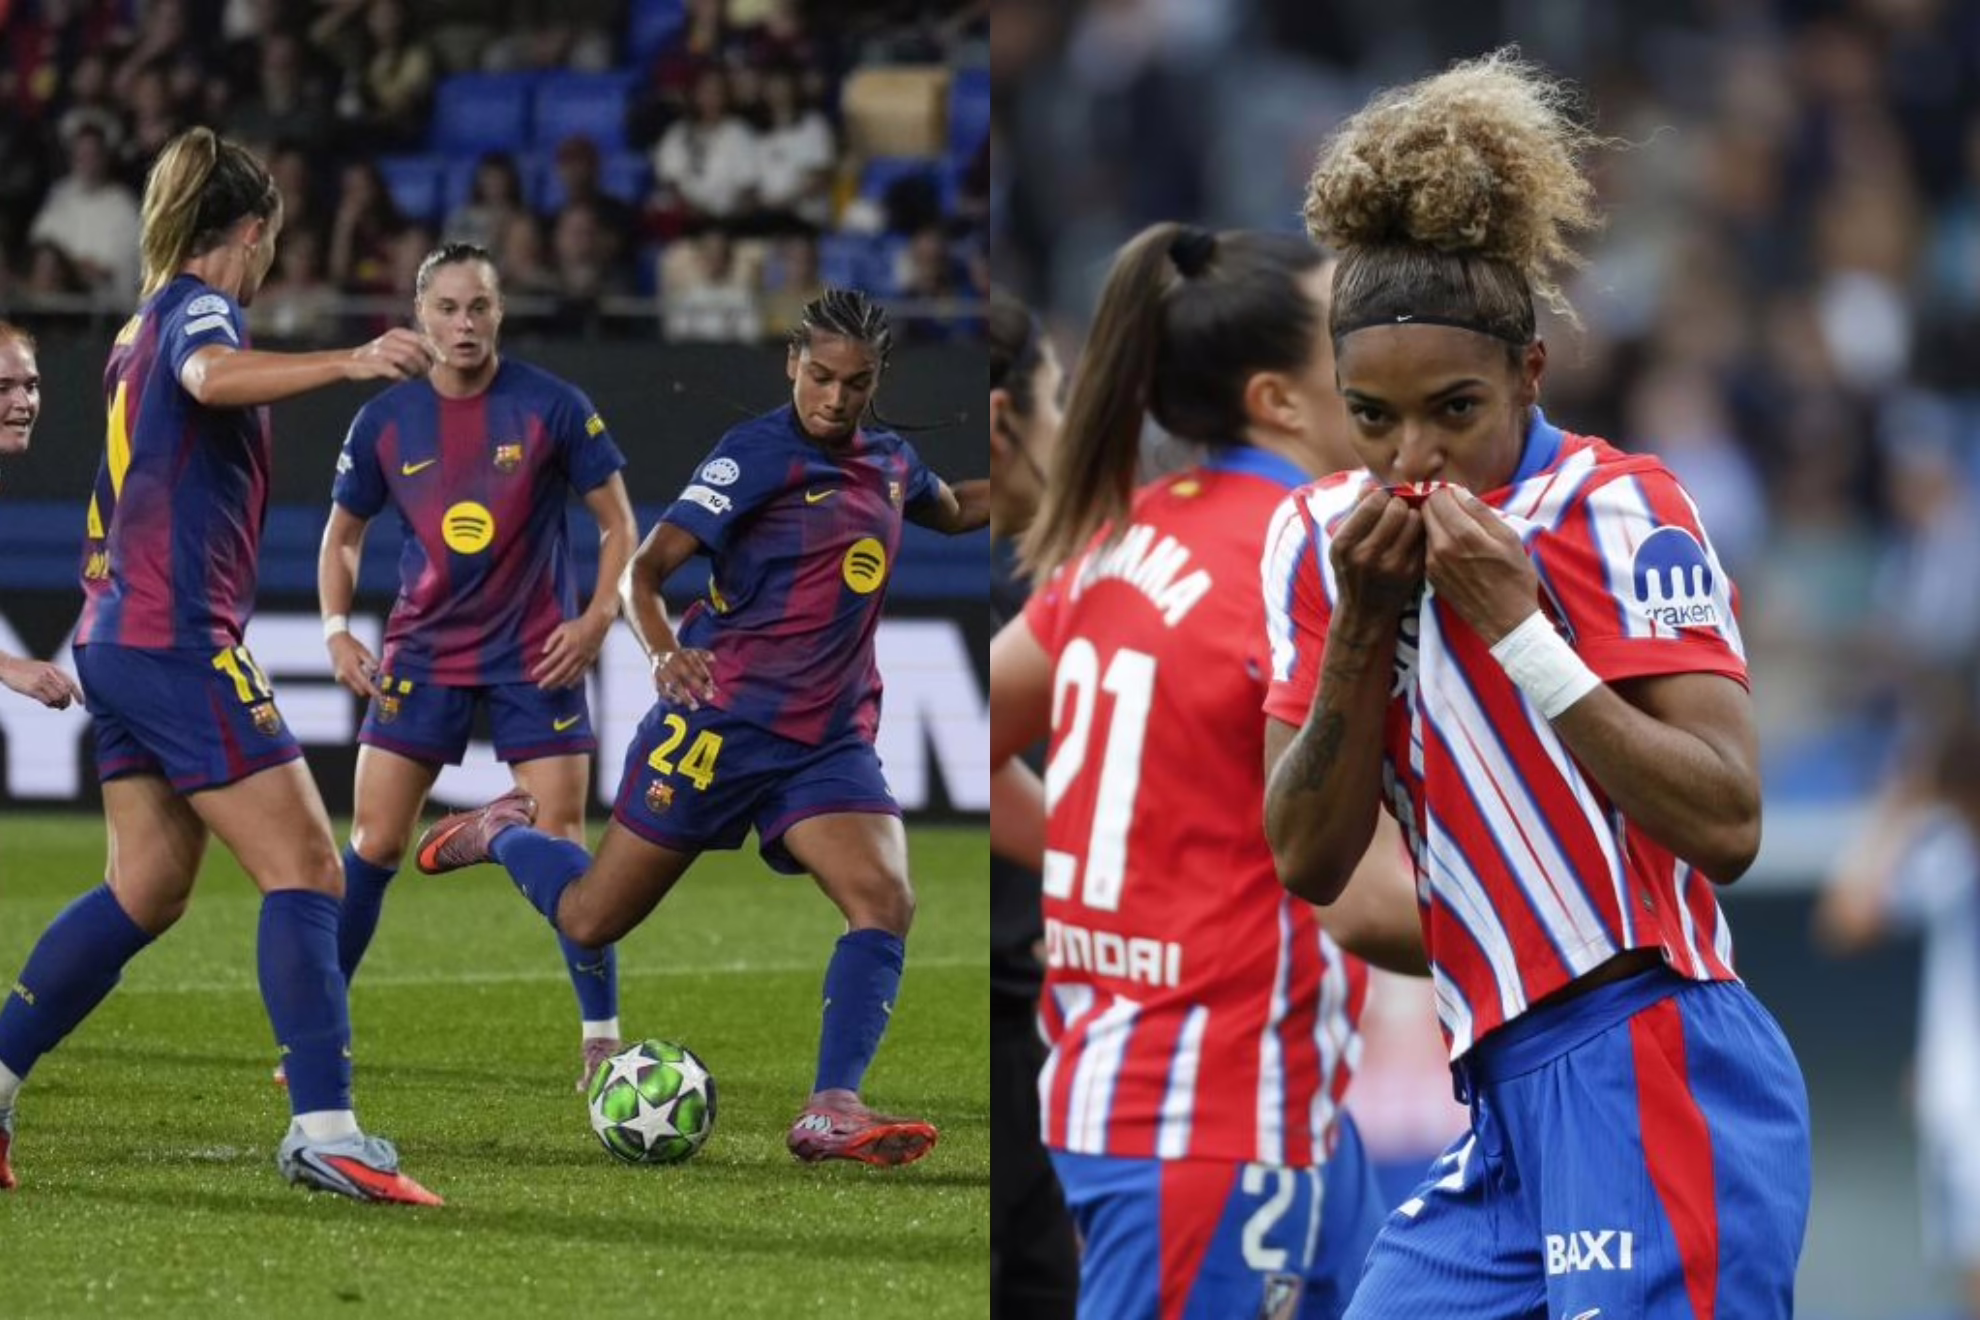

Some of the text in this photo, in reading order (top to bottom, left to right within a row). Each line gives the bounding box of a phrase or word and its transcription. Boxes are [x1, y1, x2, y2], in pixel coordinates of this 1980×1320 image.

[648, 713, 723, 791] 24
[1043, 638, 1157, 912] 21
[1545, 1229, 1633, 1275] BAXI
